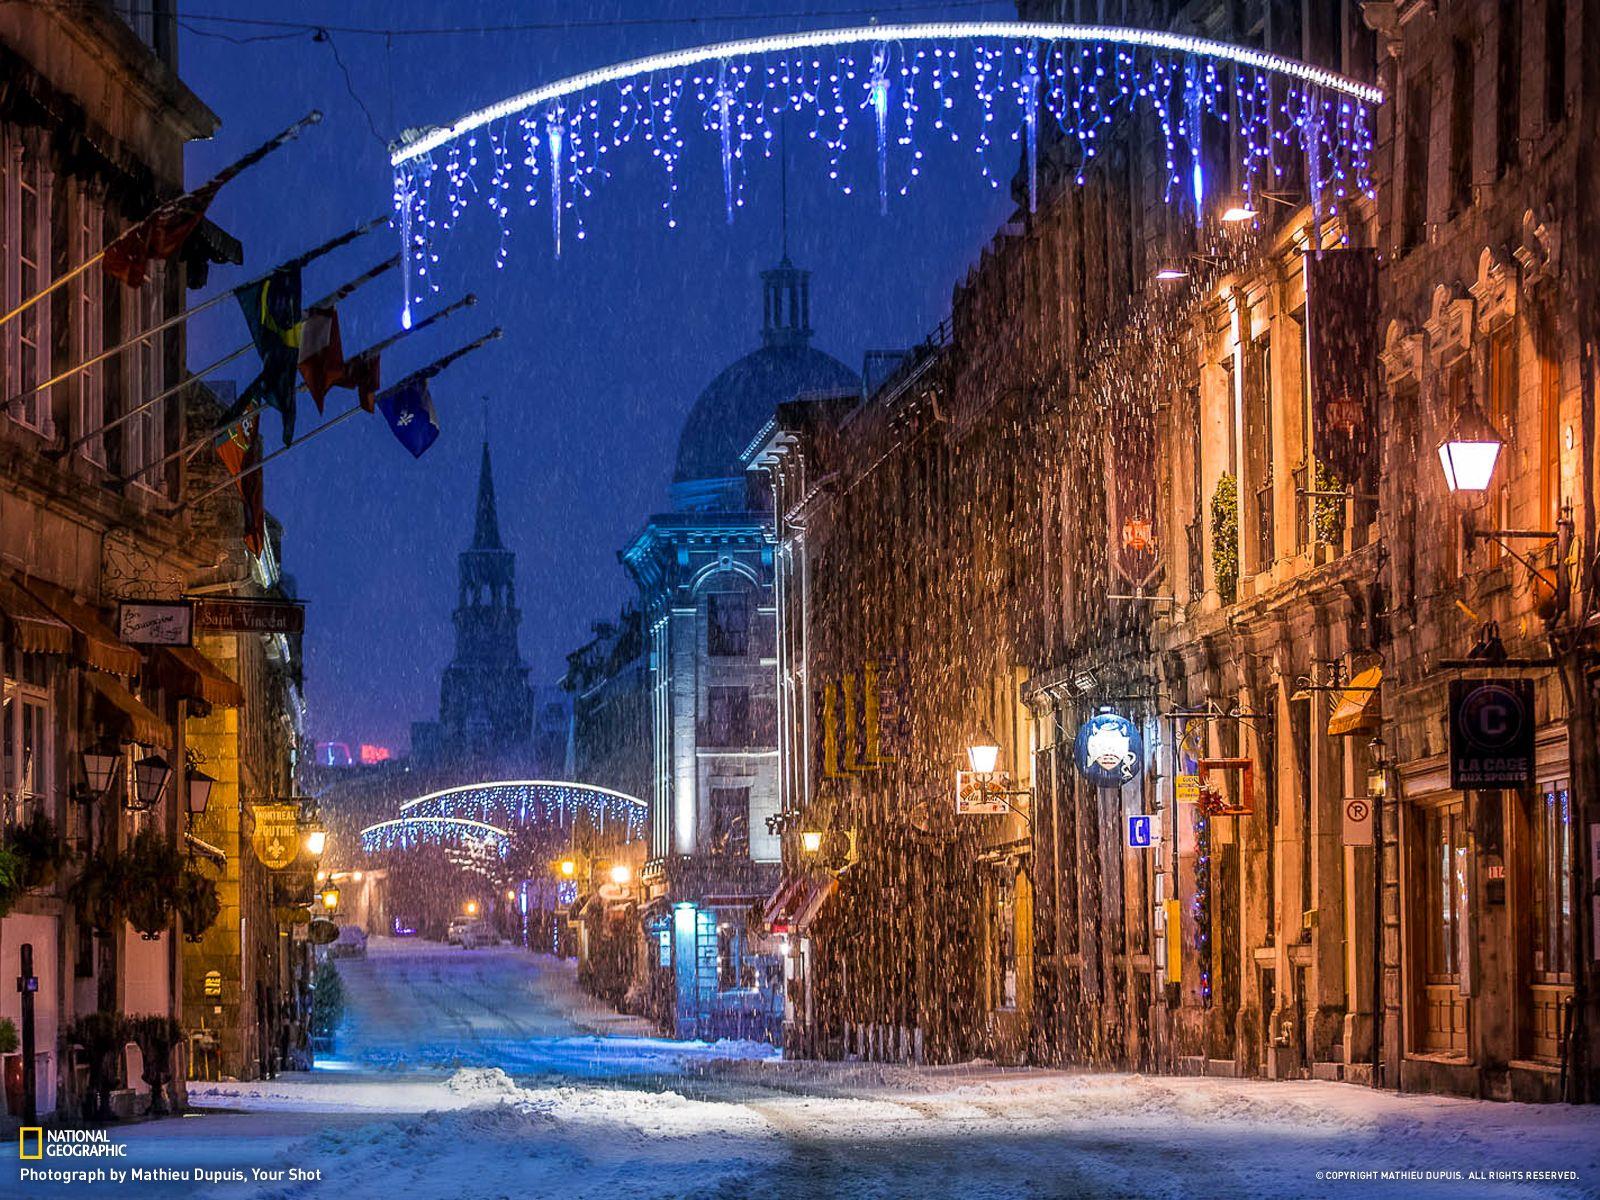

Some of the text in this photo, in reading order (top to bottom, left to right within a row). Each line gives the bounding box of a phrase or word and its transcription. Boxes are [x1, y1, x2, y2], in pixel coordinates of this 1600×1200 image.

[1458, 757, 1528, 772] LA CAGE
[1459, 771, 1528, 782] AUX SPORTS
[256, 825, 296, 837] POUTINE
